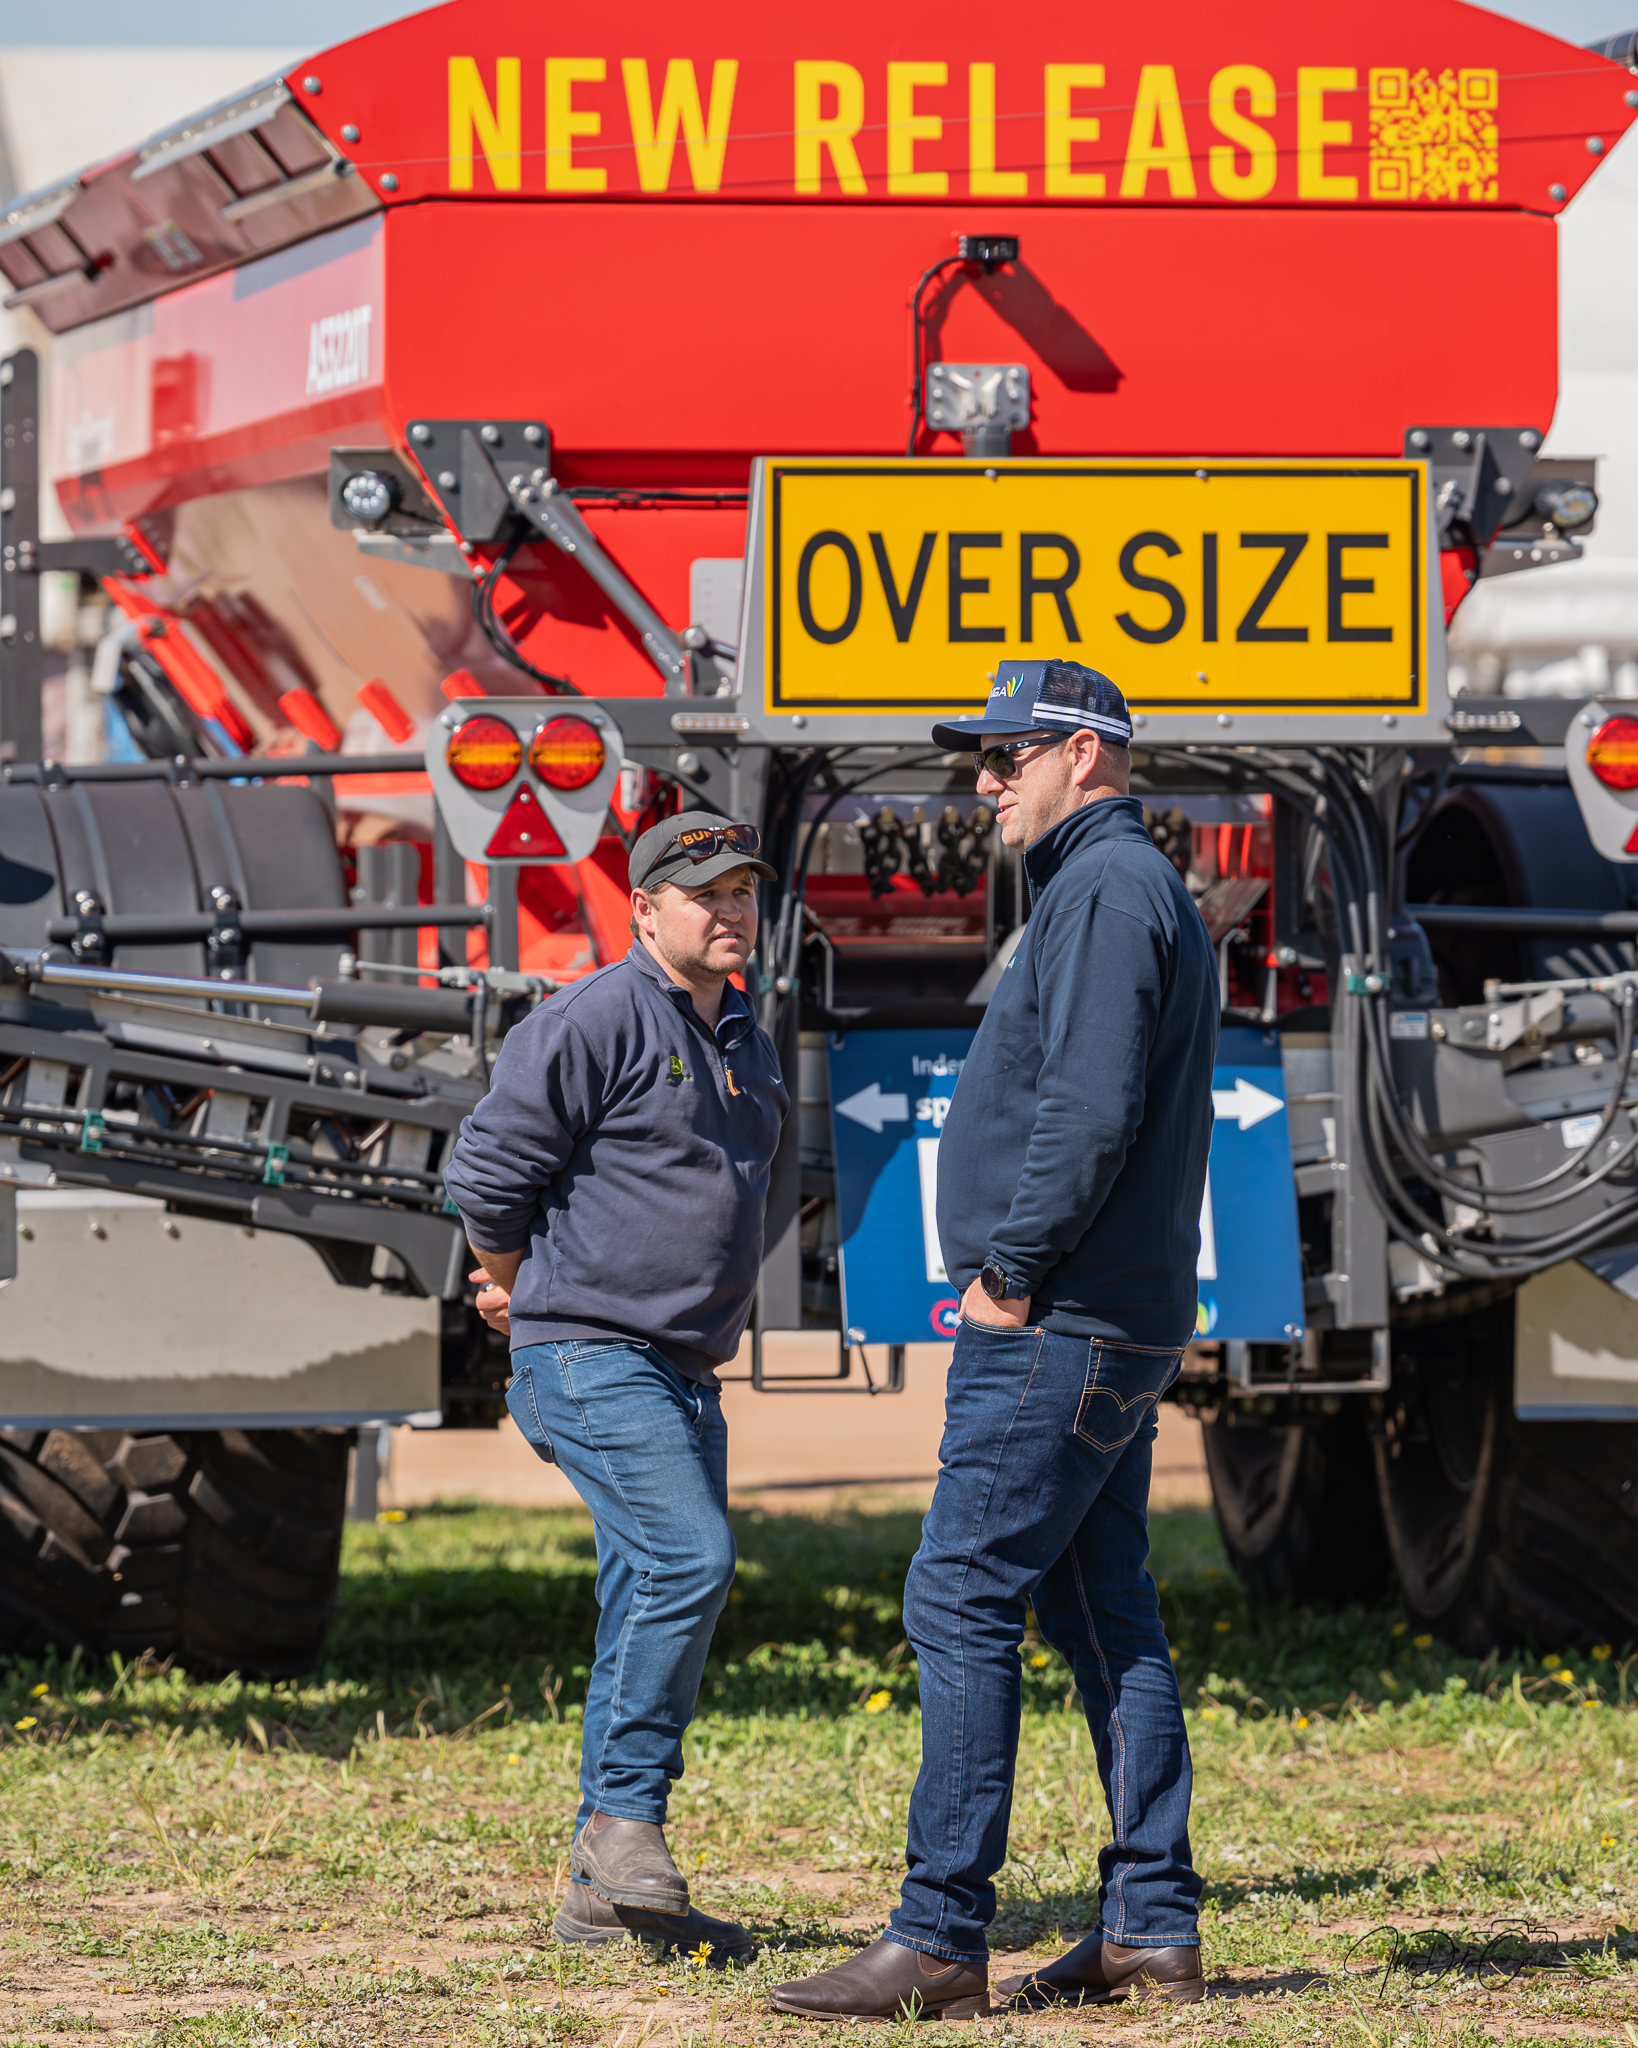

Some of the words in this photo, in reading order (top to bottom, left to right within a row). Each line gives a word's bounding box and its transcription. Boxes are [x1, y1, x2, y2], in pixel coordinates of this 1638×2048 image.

[448, 57, 739, 192] NEW
[795, 60, 1359, 201] RELEASE
[796, 530, 1083, 644] OVER
[1115, 531, 1394, 645] SIZE
